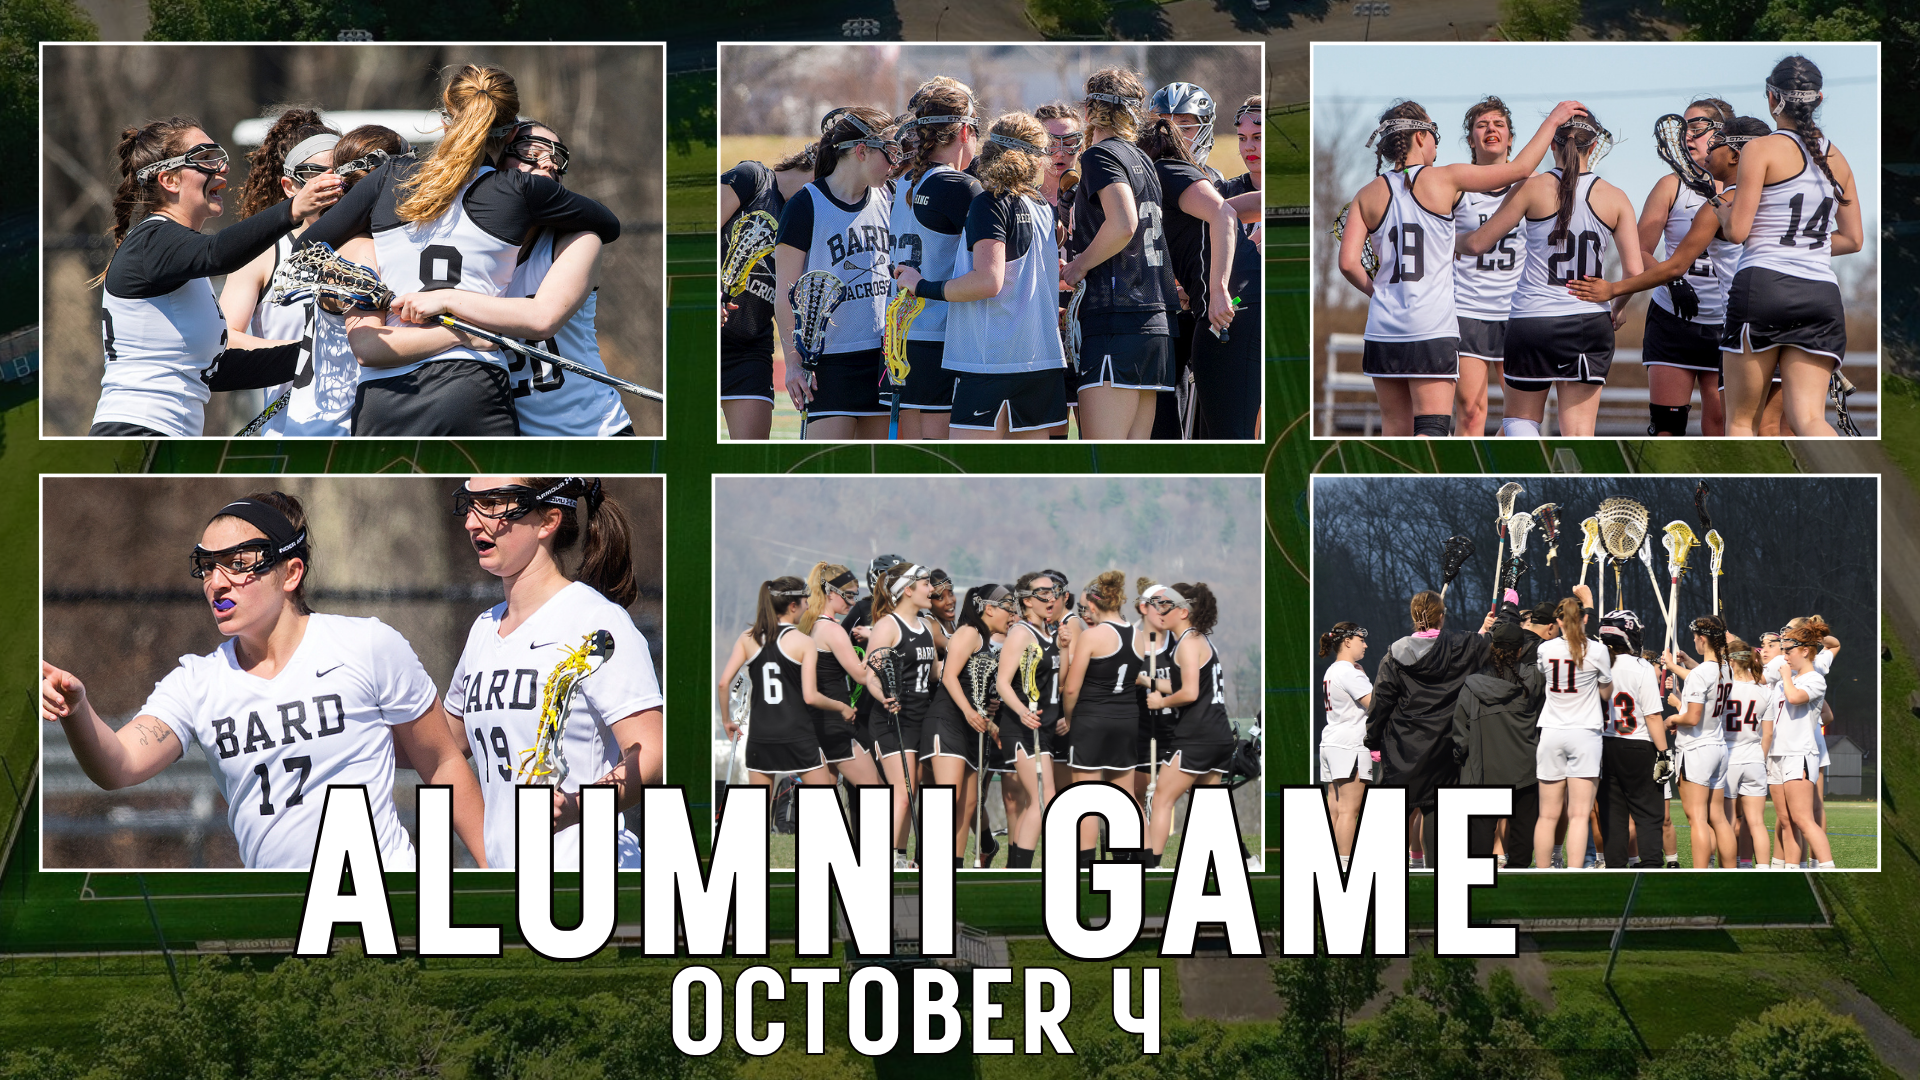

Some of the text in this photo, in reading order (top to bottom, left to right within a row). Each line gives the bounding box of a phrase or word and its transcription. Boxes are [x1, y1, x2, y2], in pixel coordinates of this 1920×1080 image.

[1139, 201, 1163, 267] 2
[1780, 193, 1833, 250] 14
[1388, 223, 1424, 284] 19
[1547, 229, 1603, 286] 20
[1624, 619, 1634, 630] 33
[762, 661, 783, 705] 6
[1112, 663, 1128, 694] 1
[1548, 658, 1578, 693] 11
[211, 693, 346, 760] BARD
[1726, 699, 1759, 732] 24
[474, 726, 513, 784] 19
[253, 755, 312, 816] 17
